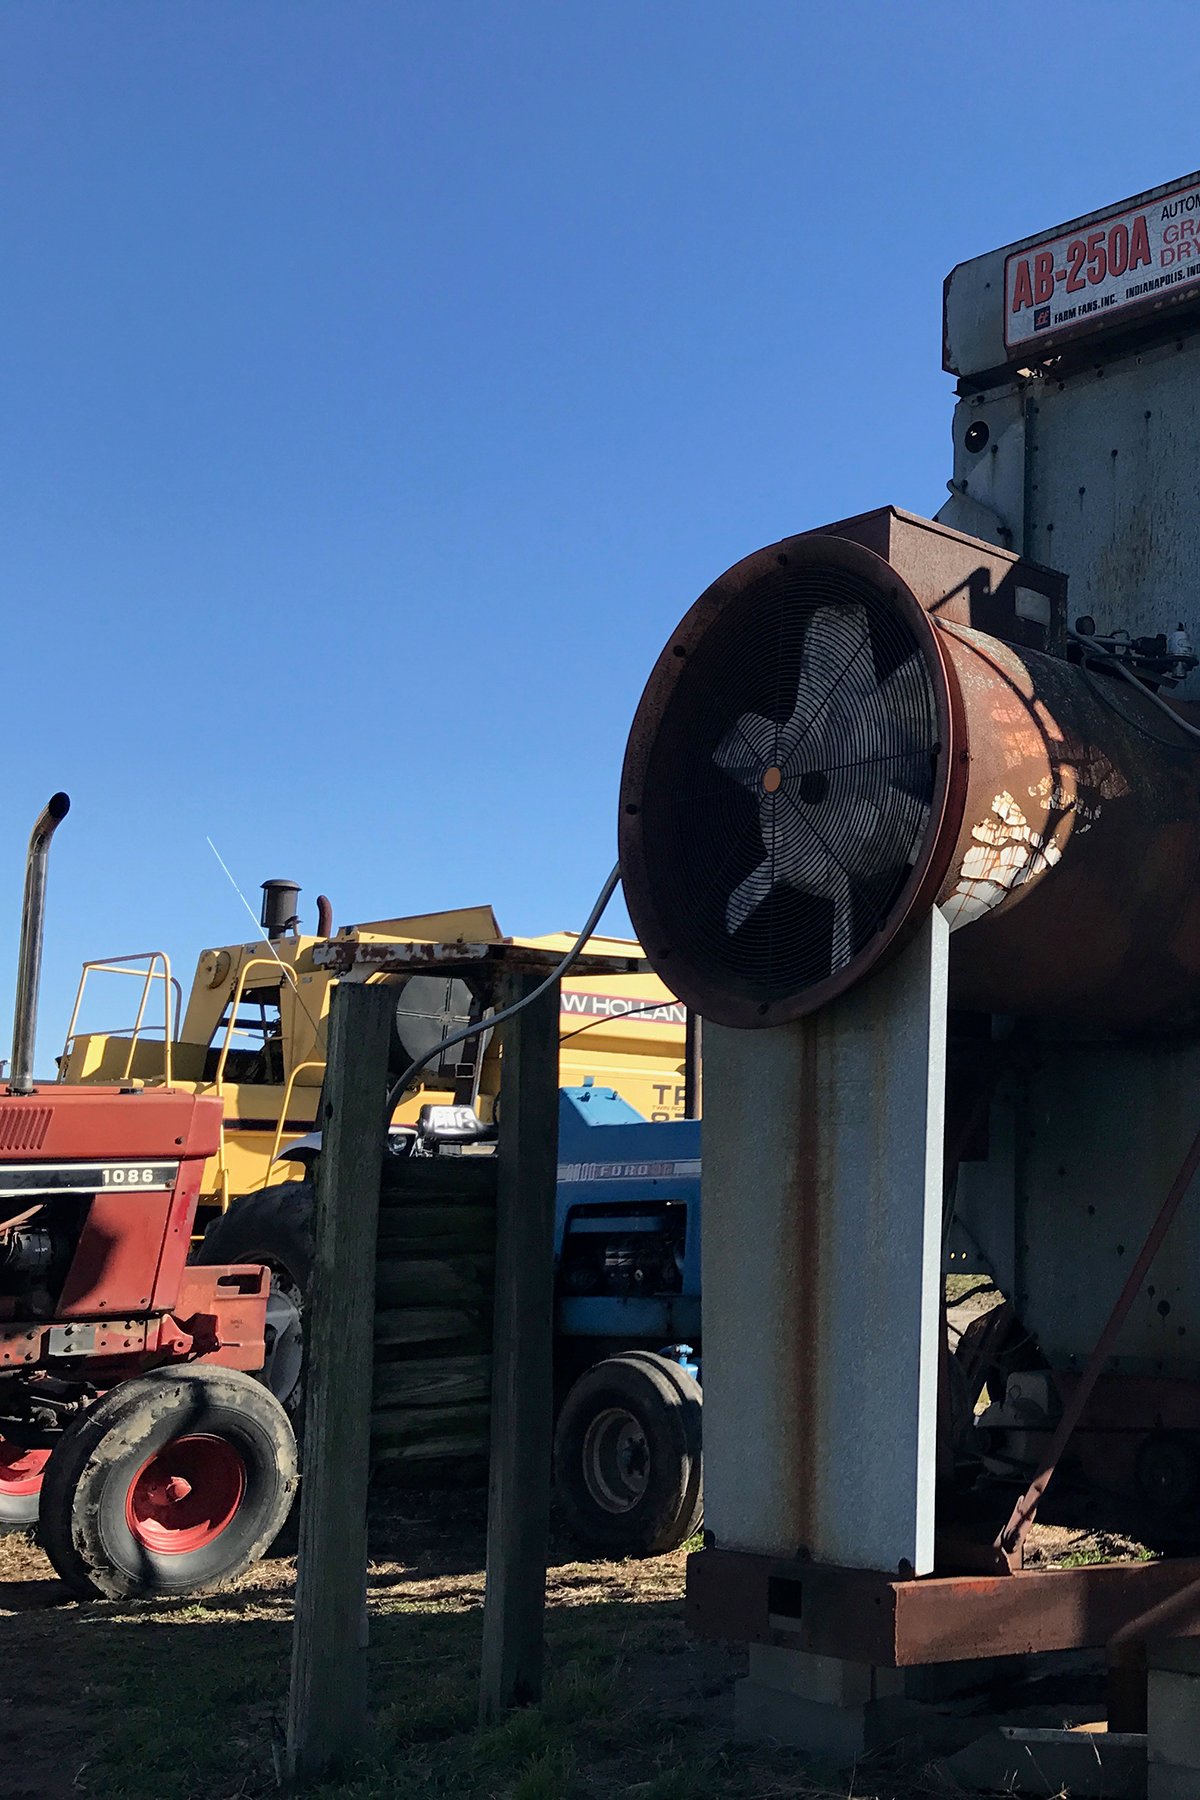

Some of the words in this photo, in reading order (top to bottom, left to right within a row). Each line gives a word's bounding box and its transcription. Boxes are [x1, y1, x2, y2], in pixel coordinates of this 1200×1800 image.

[1012, 215, 1152, 313] AB-250A
[1054, 306, 1077, 324] FARM
[102, 1169, 153, 1184] 1086
[599, 1164, 649, 1177] FORD
